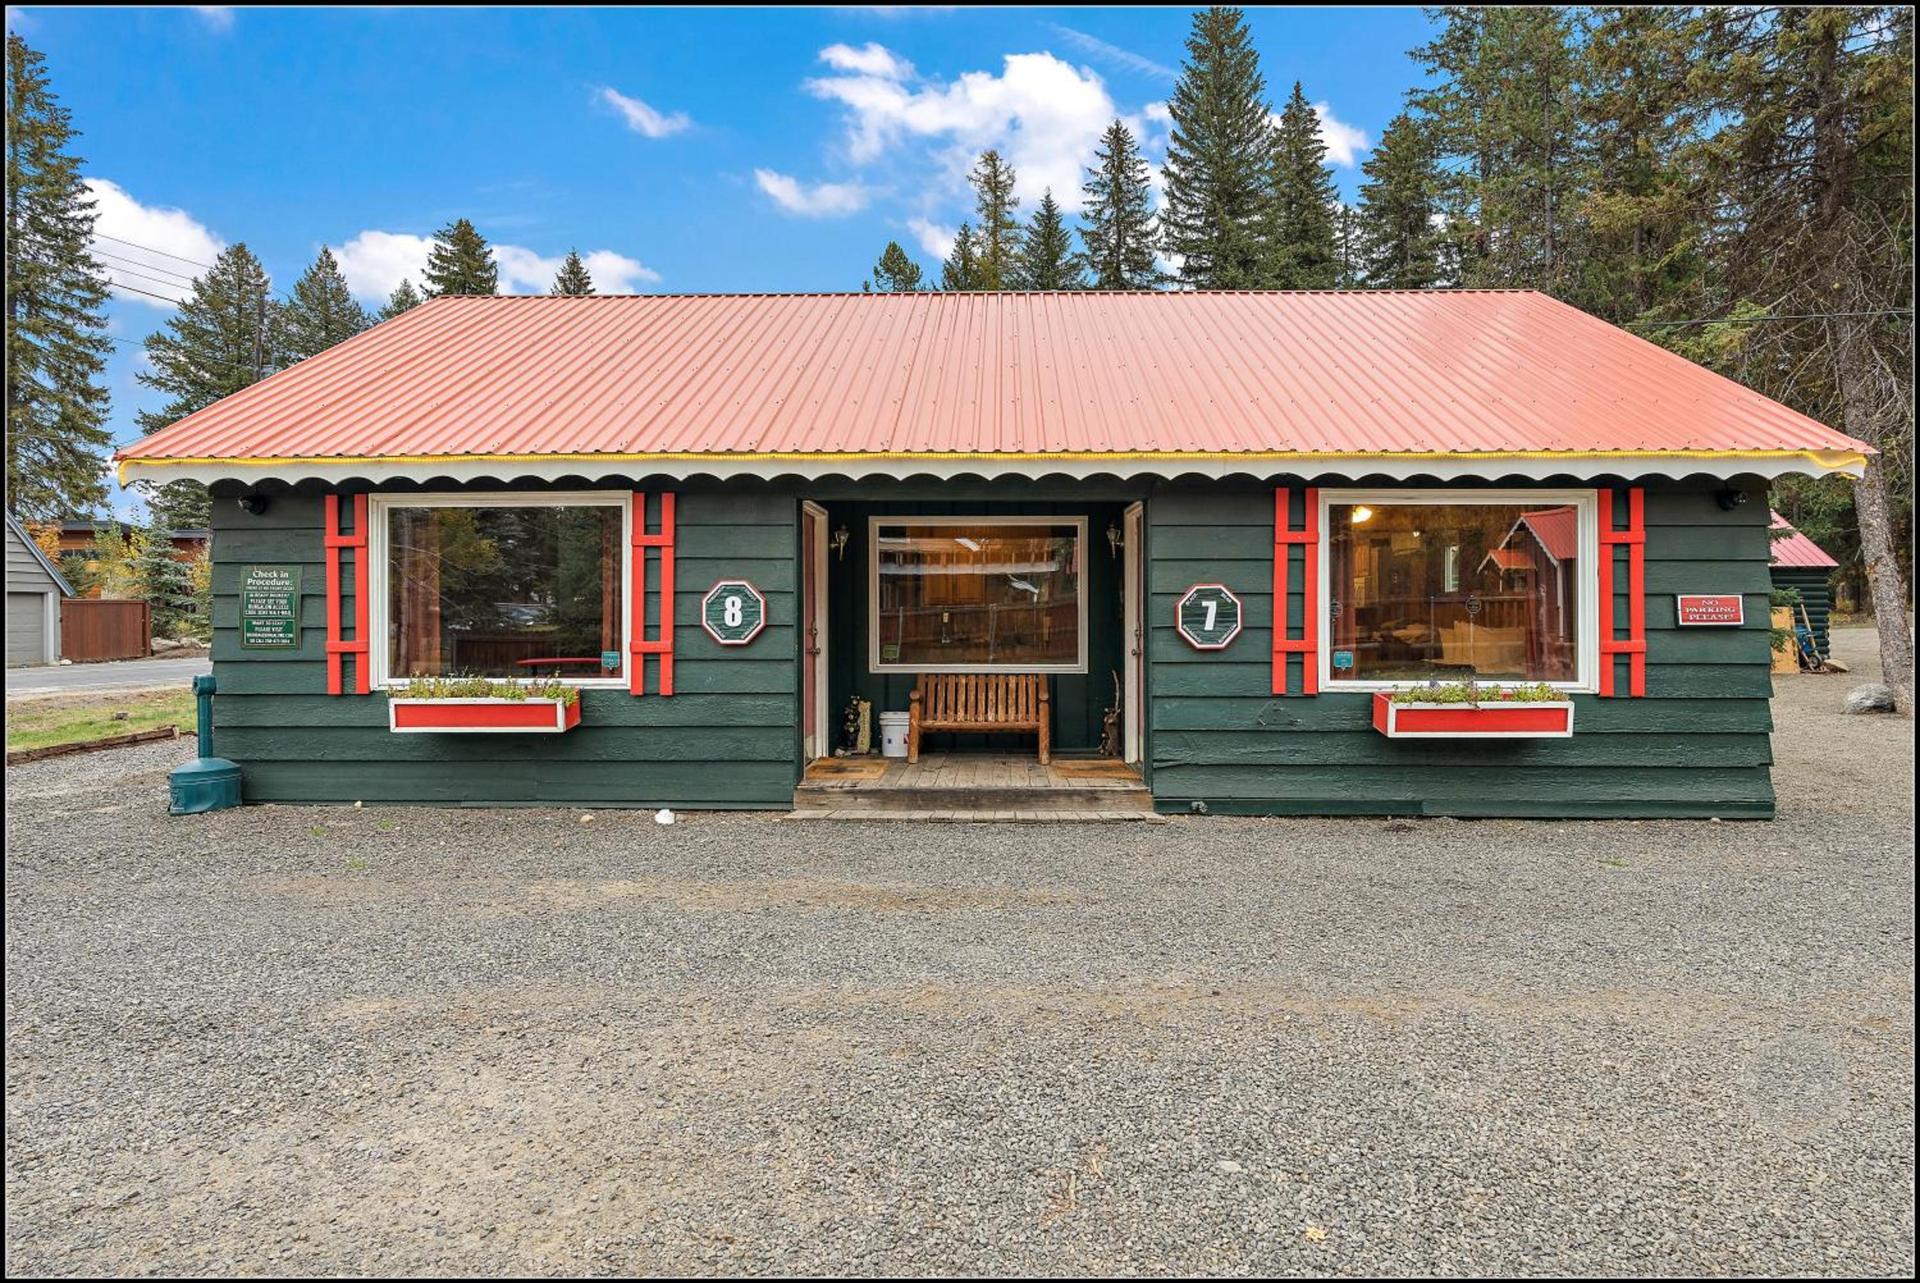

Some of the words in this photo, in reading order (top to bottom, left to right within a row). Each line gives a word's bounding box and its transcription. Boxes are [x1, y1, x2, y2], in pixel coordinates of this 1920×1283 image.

[252, 570, 278, 578] Check
[724, 595, 743, 627] 8
[1201, 600, 1217, 631] 7
